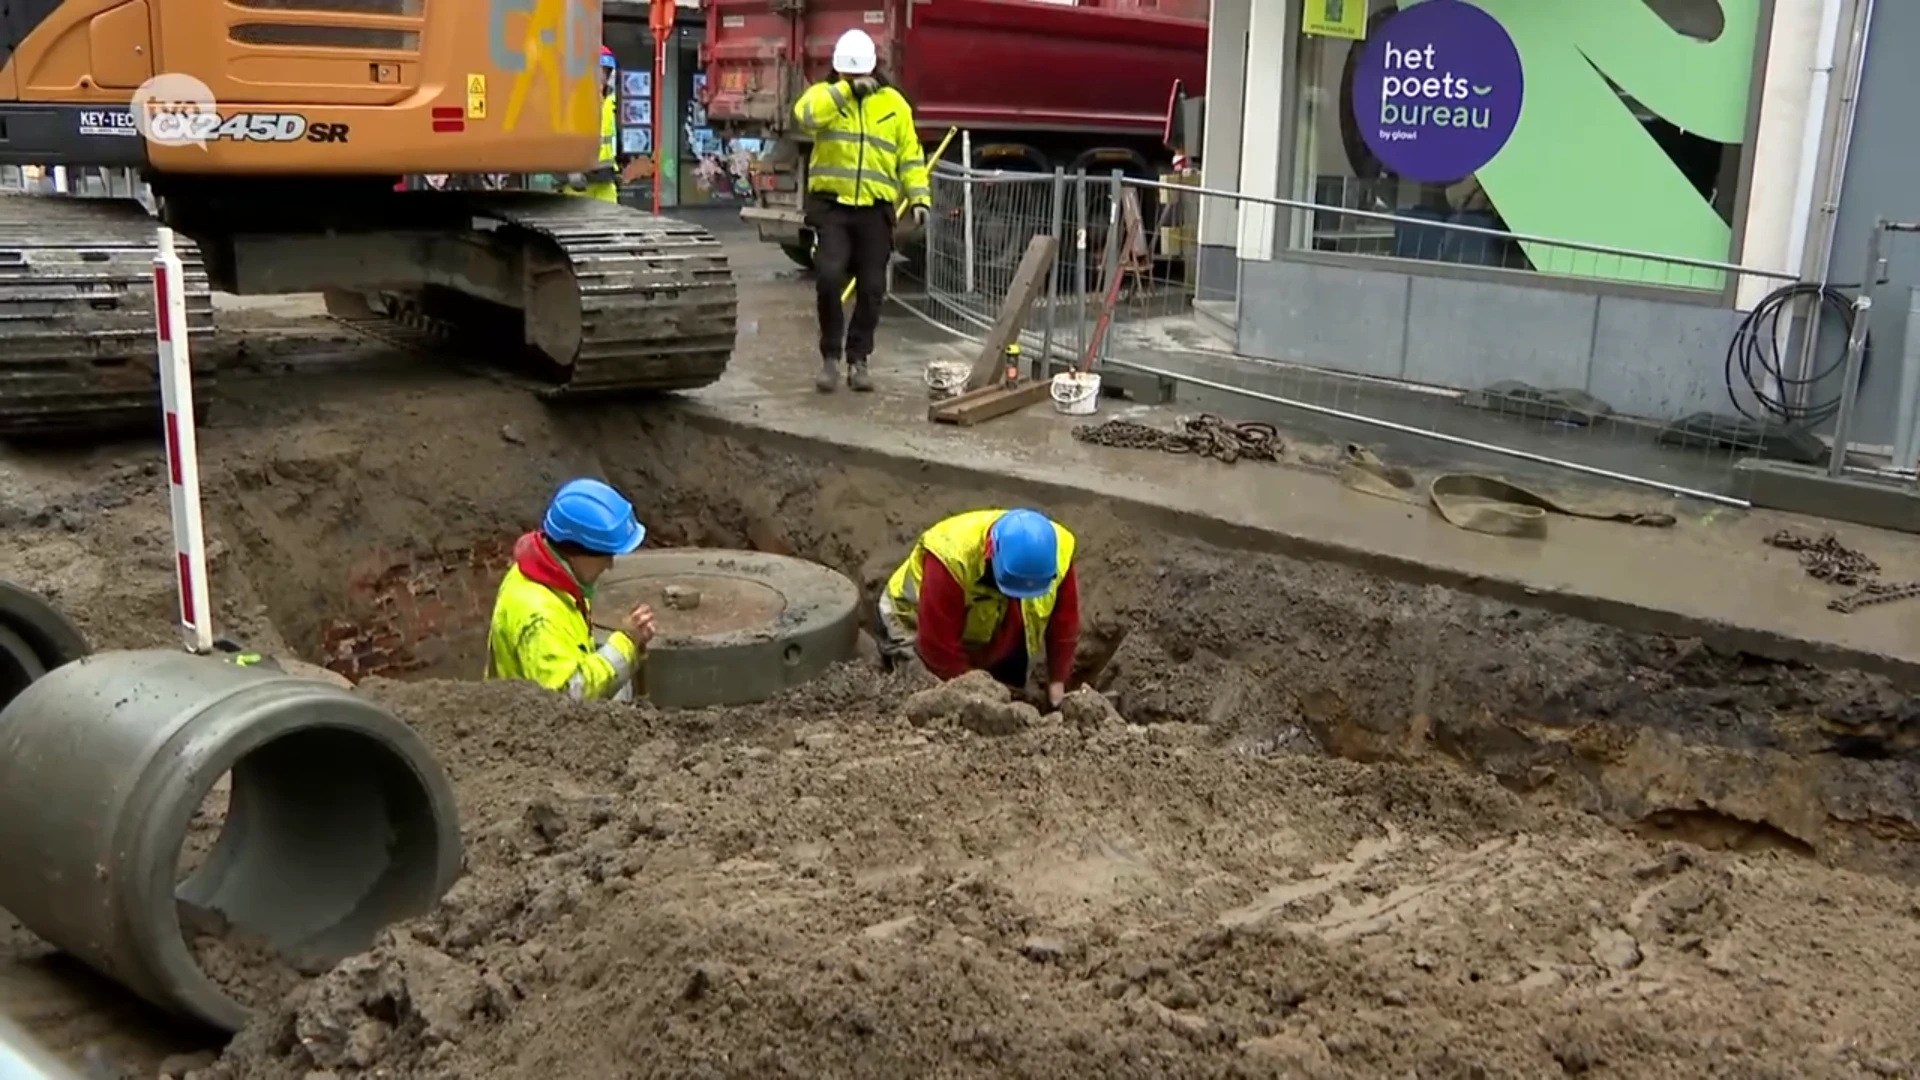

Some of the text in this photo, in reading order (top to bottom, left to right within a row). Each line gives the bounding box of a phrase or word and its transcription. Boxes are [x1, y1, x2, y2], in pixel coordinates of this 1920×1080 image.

[1384, 41, 1435, 70] het
[1382, 72, 1469, 103] poets
[80, 111, 134, 127] KEY-TEC
[152, 112, 349, 142] CX245D SR
[1381, 102, 1490, 129] bureau
[1379, 129, 1391, 141] by
